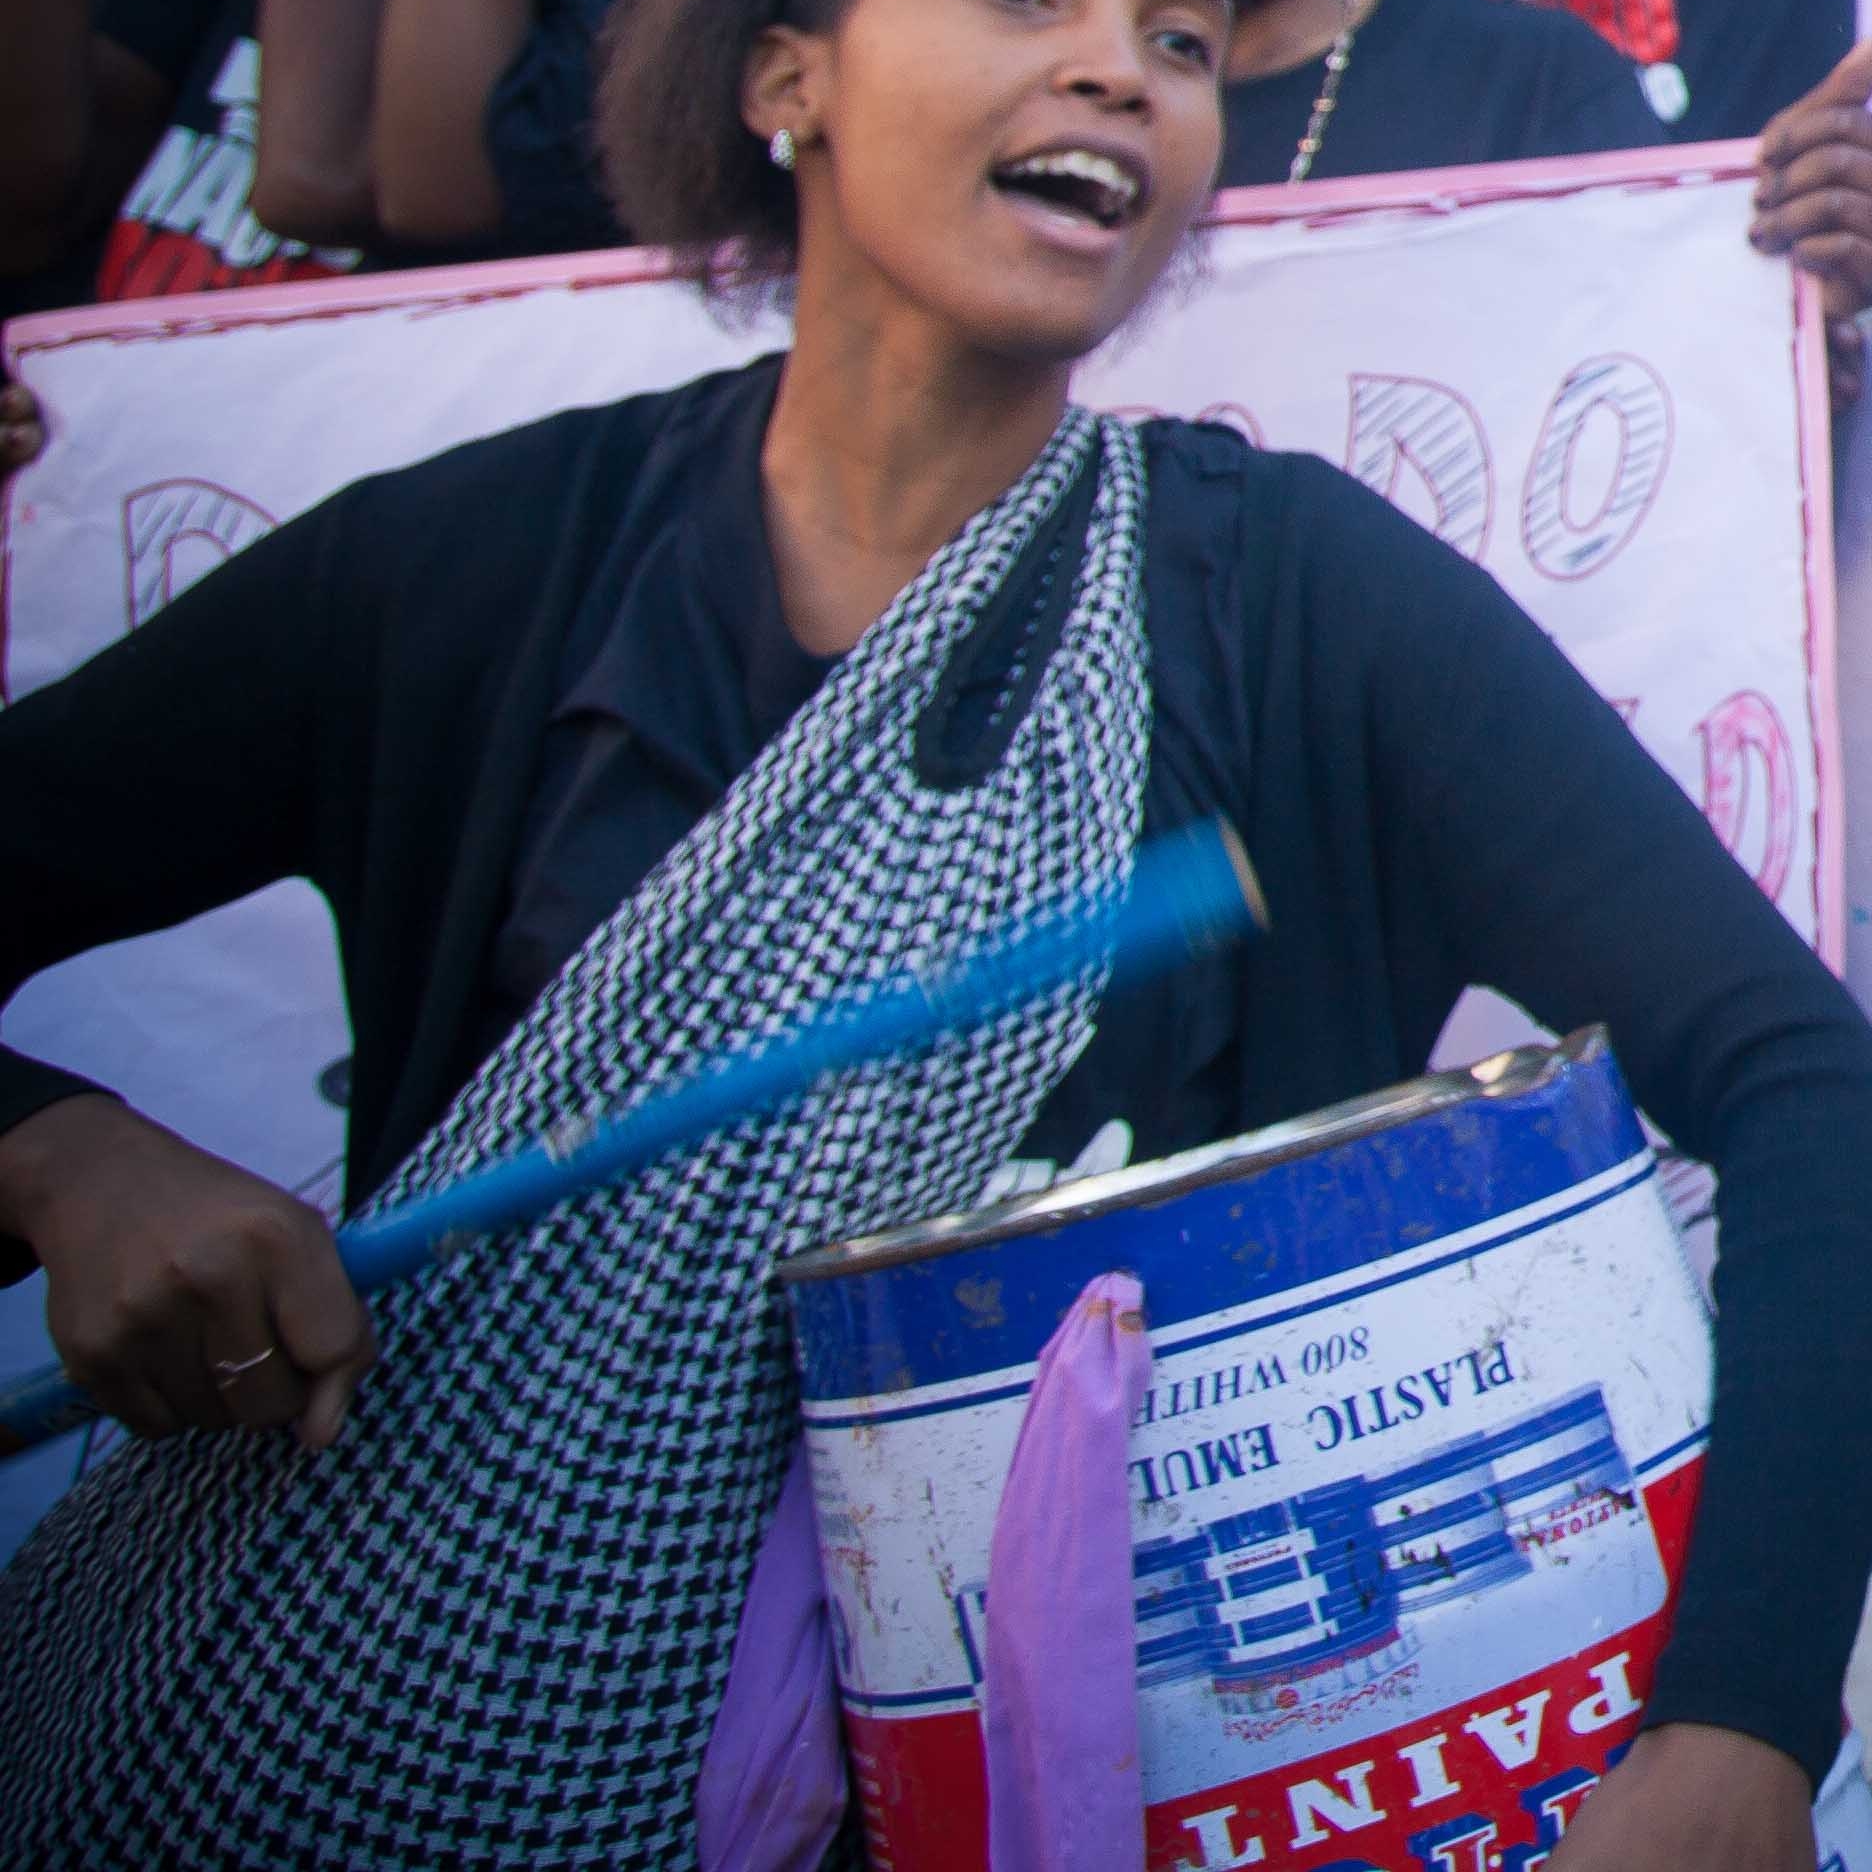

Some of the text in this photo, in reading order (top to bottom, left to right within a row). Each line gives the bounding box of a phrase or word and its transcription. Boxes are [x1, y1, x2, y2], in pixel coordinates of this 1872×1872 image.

[1133, 1342, 1515, 1503] PLASTIC EMUL
[1298, 1325, 1371, 1376] 800
[1176, 1648, 1646, 1872] PAINT
